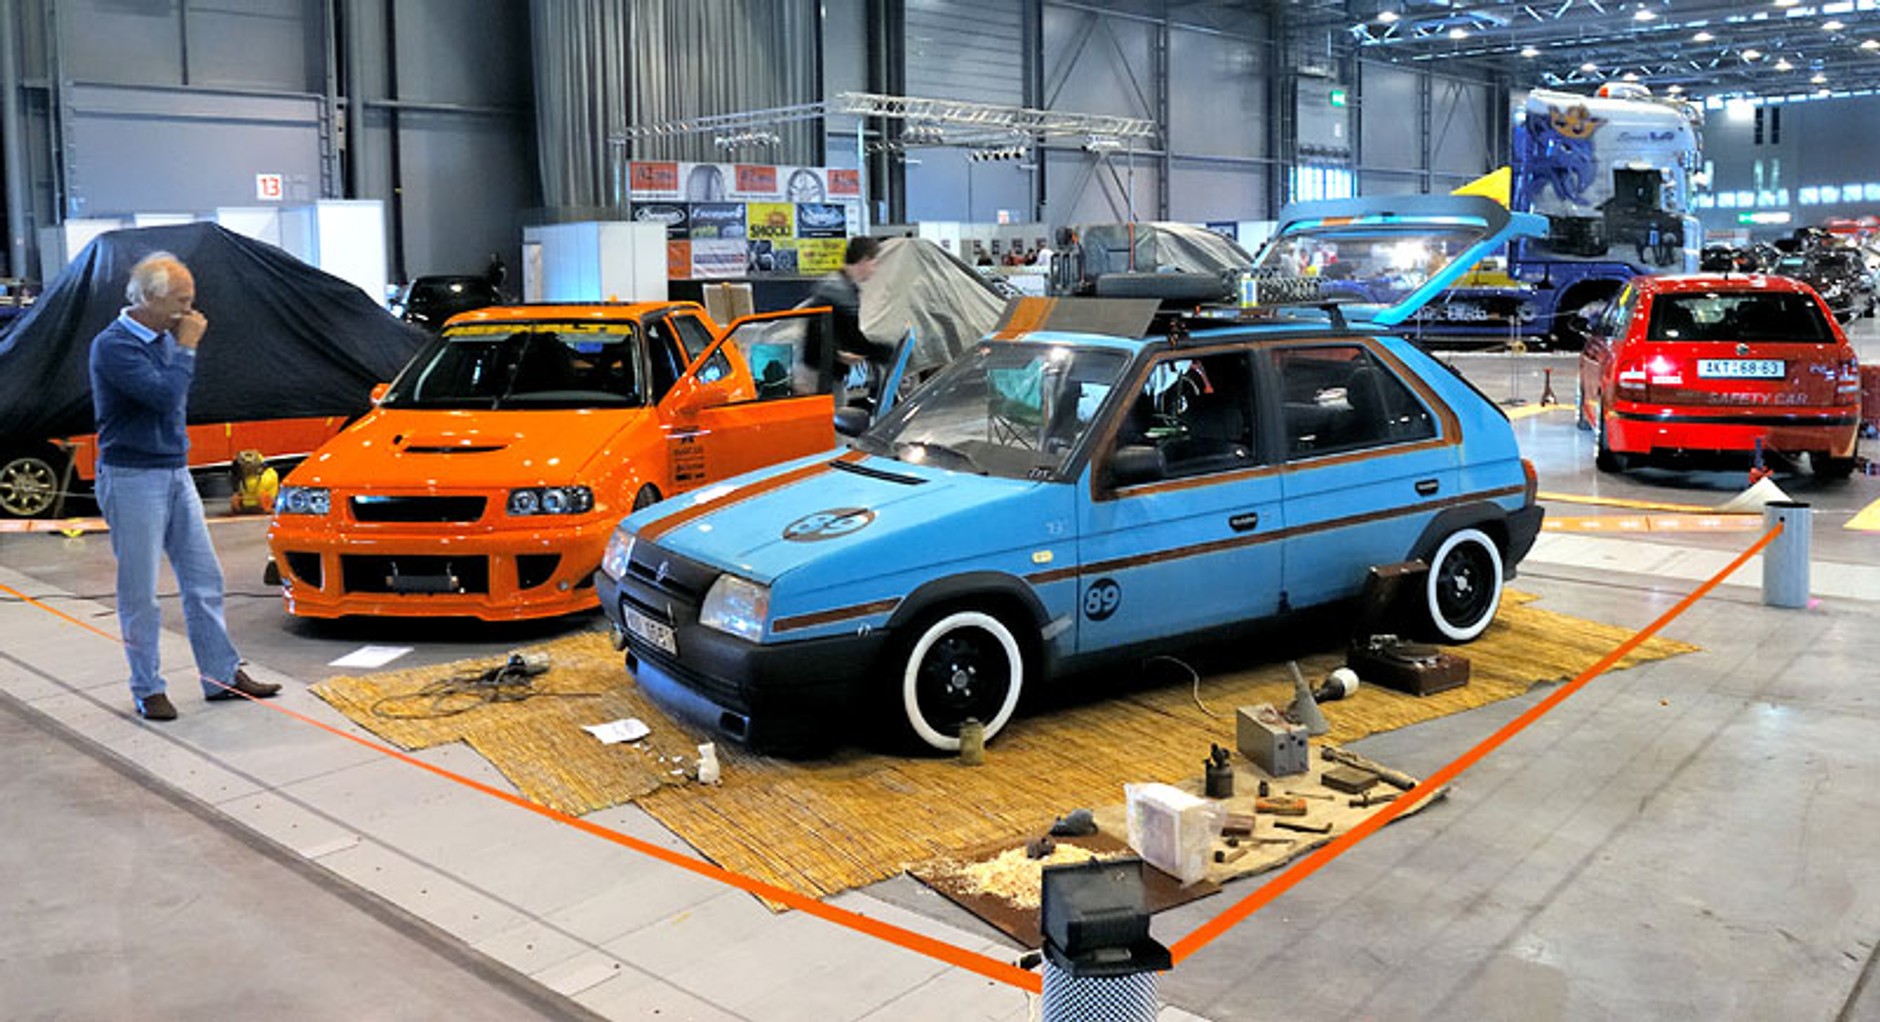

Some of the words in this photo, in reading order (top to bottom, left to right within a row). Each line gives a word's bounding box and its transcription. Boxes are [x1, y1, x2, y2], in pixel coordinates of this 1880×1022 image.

[261, 177, 280, 196] 13
[1706, 361, 1730, 373] AKT
[1739, 361, 1779, 375] 68-63
[1708, 391, 1770, 405] SAFETY
[1774, 392, 1808, 405] CAR
[1087, 583, 1120, 615] 89
